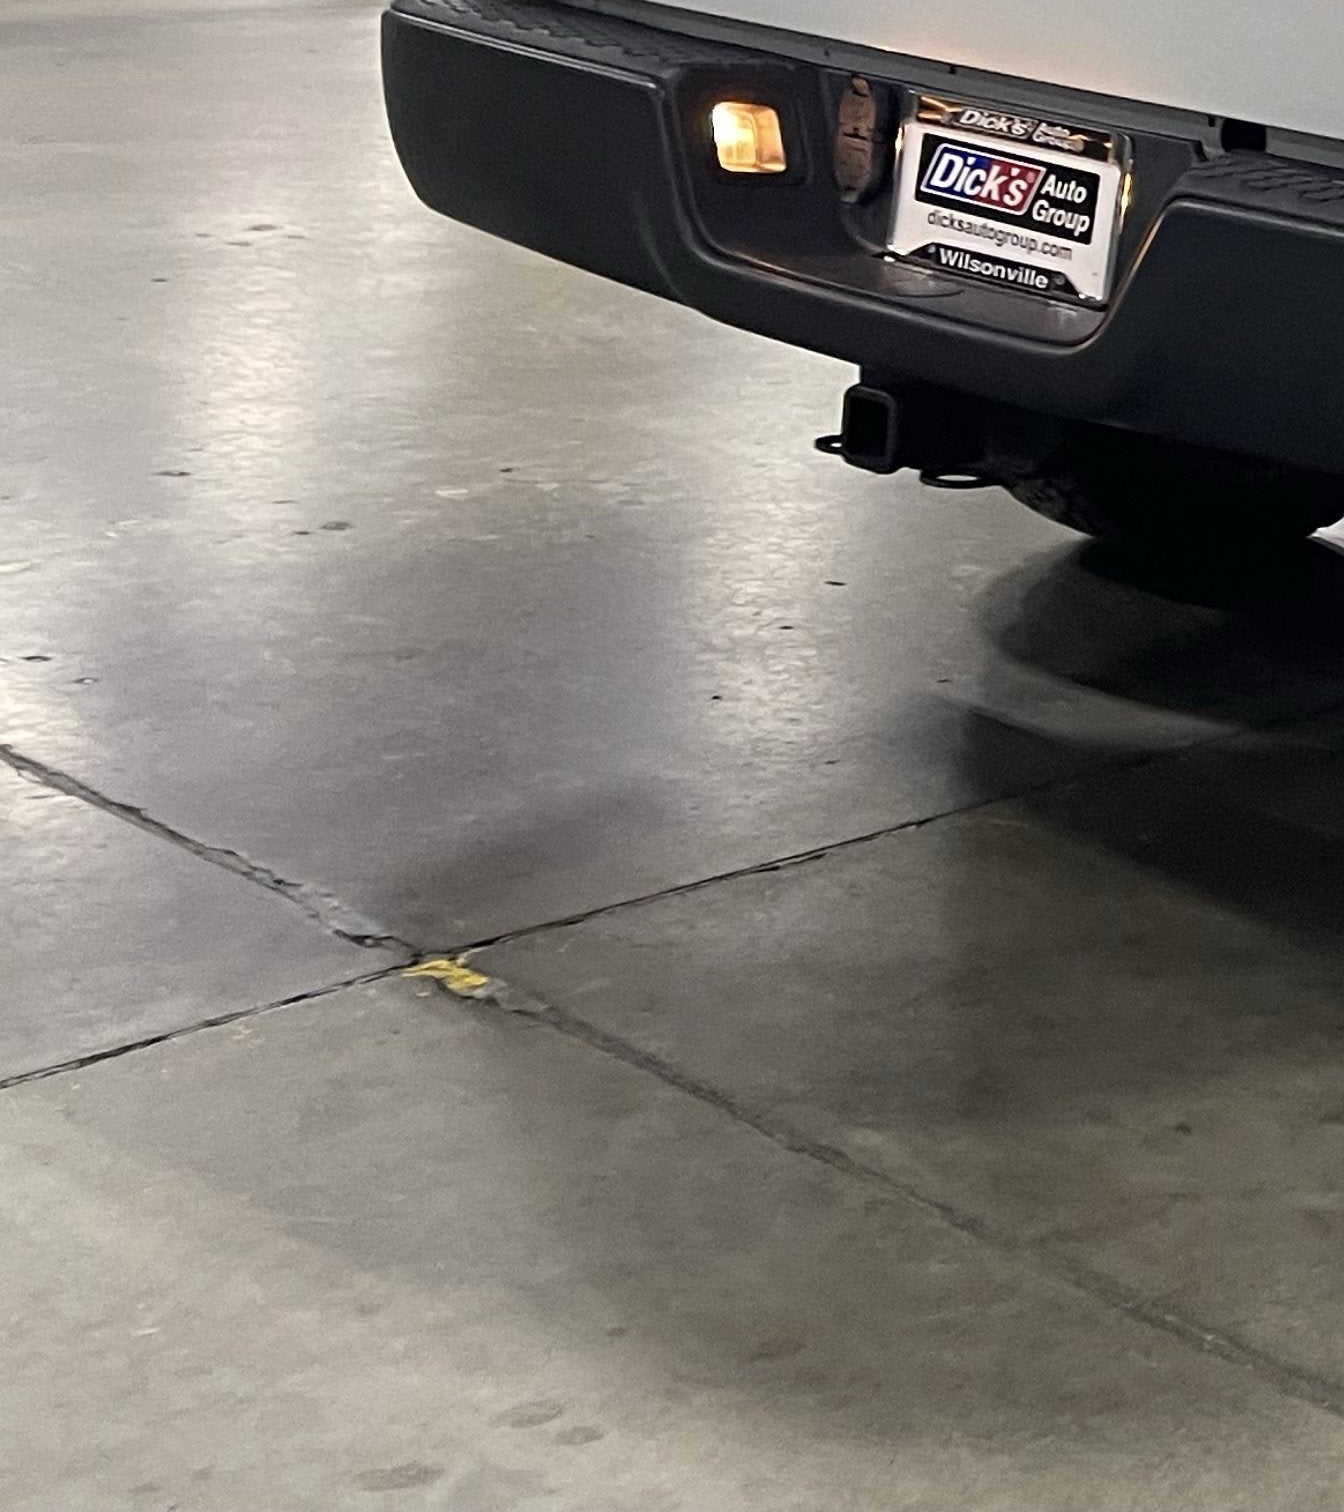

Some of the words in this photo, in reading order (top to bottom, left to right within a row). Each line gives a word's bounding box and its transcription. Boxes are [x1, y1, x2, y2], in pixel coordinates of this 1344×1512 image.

[959, 110, 1028, 136] Dick's
[930, 152, 1029, 208] Dick's
[1041, 174, 1088, 204] Auto
[927, 210, 1073, 261] dicksautogroup.com
[1032, 200, 1091, 237] Group
[938, 246, 1050, 289] Wilsonville
